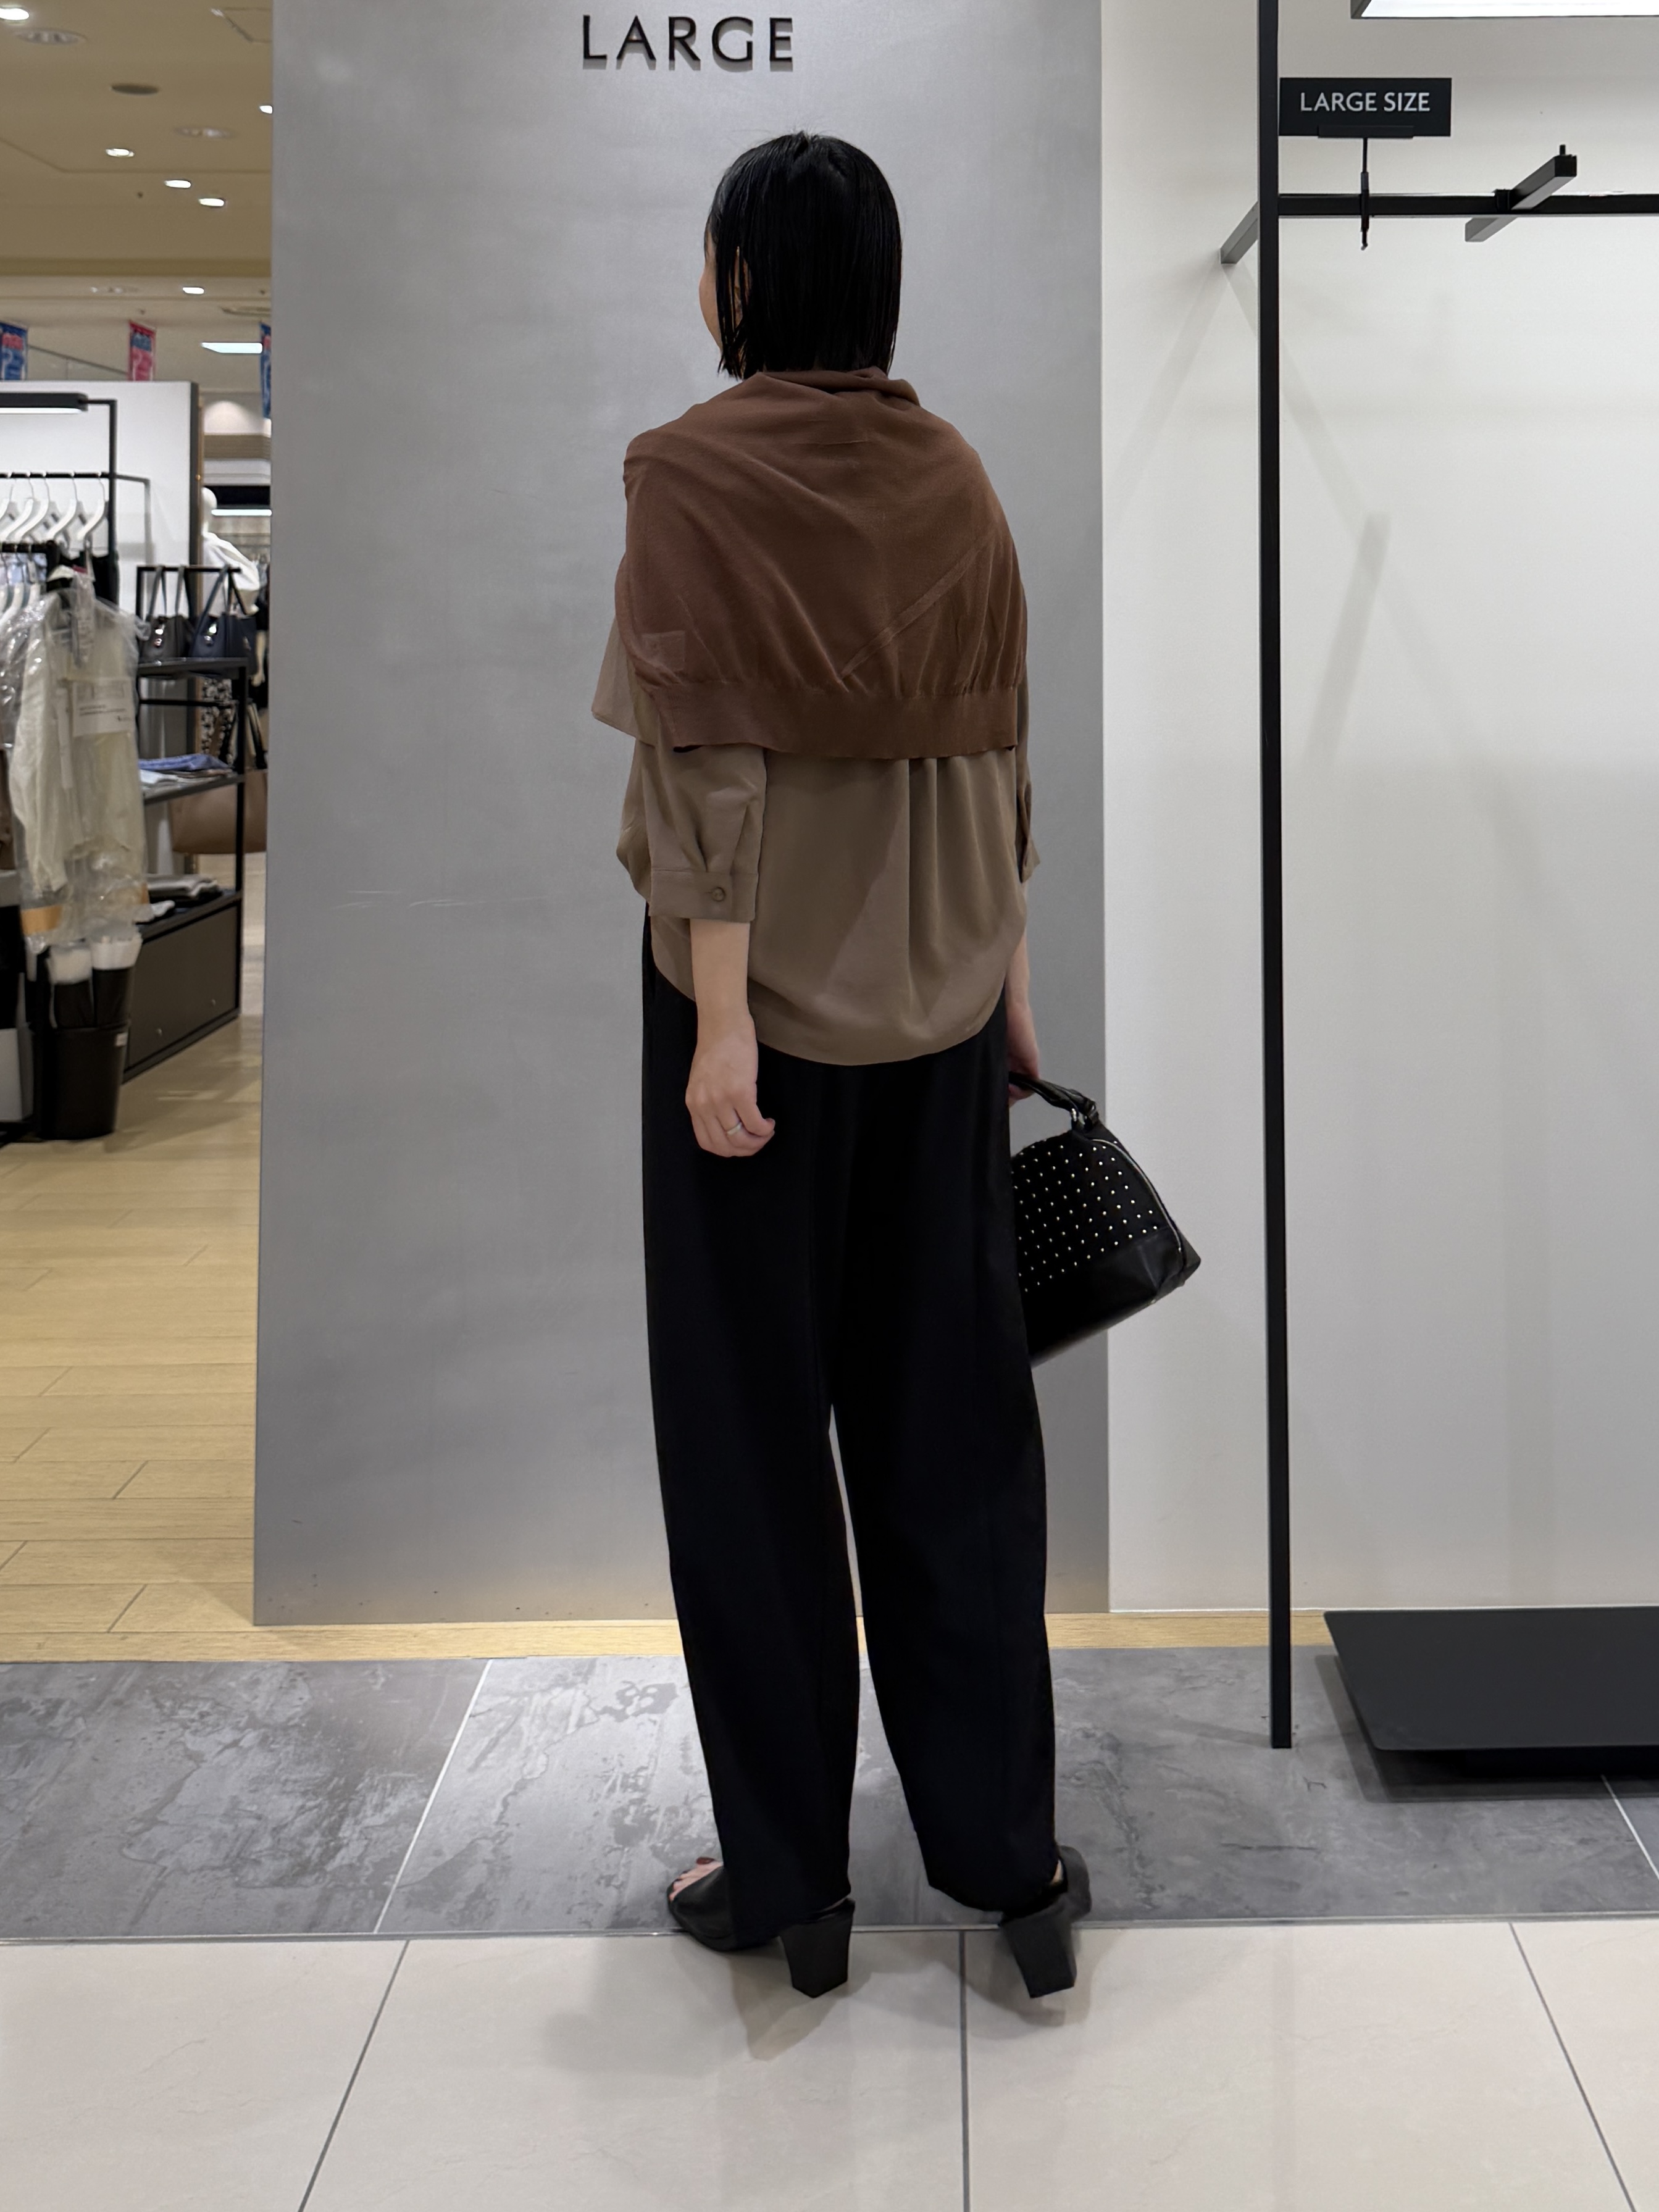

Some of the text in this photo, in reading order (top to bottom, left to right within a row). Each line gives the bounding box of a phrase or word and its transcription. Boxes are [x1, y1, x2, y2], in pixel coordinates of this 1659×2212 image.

[582, 15, 793, 63] LARGE
[1300, 92, 1431, 112] LARGE SIZE
